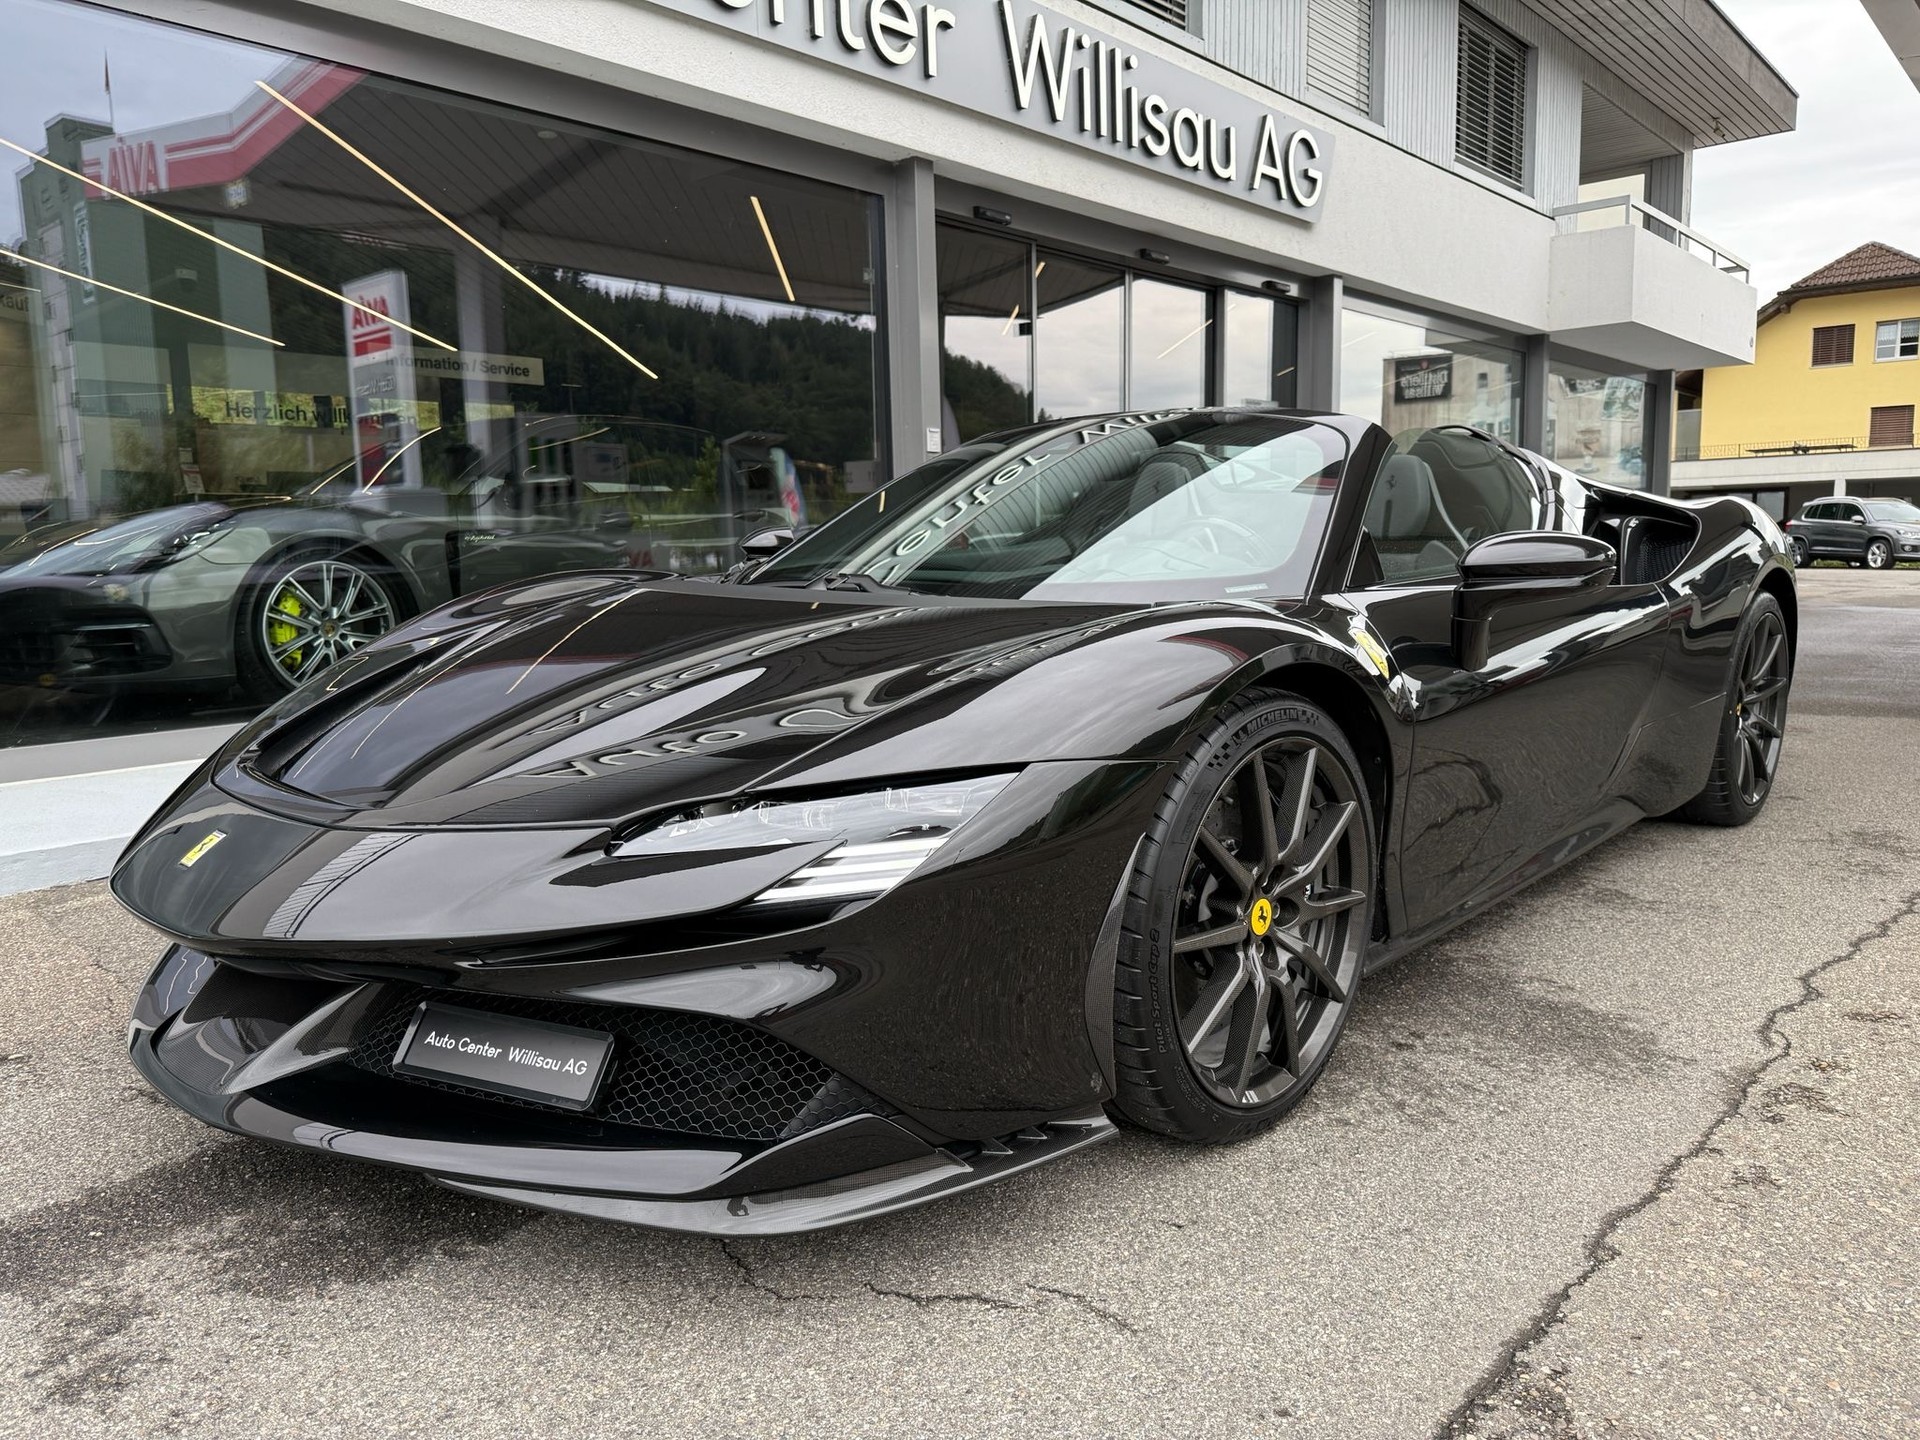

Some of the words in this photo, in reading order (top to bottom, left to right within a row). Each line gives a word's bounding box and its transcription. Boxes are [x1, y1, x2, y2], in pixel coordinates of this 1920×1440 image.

[998, 0, 1237, 182] Willisau
[1251, 113, 1325, 209] AG
[386, 351, 469, 371] Information
[480, 360, 530, 377] Service
[226, 402, 307, 422] Herzlich
[1246, 707, 1299, 734] MICHELIN
[1149, 928, 1160, 941] 2
[1148, 942, 1159, 972] Cup
[1149, 977, 1163, 1018] Sport
[1155, 1021, 1168, 1054] Pilot
[424, 1030, 456, 1050] Auto
[458, 1037, 502, 1058] Center
[508, 1046, 562, 1071] Willisau
[562, 1058, 588, 1076] AG
